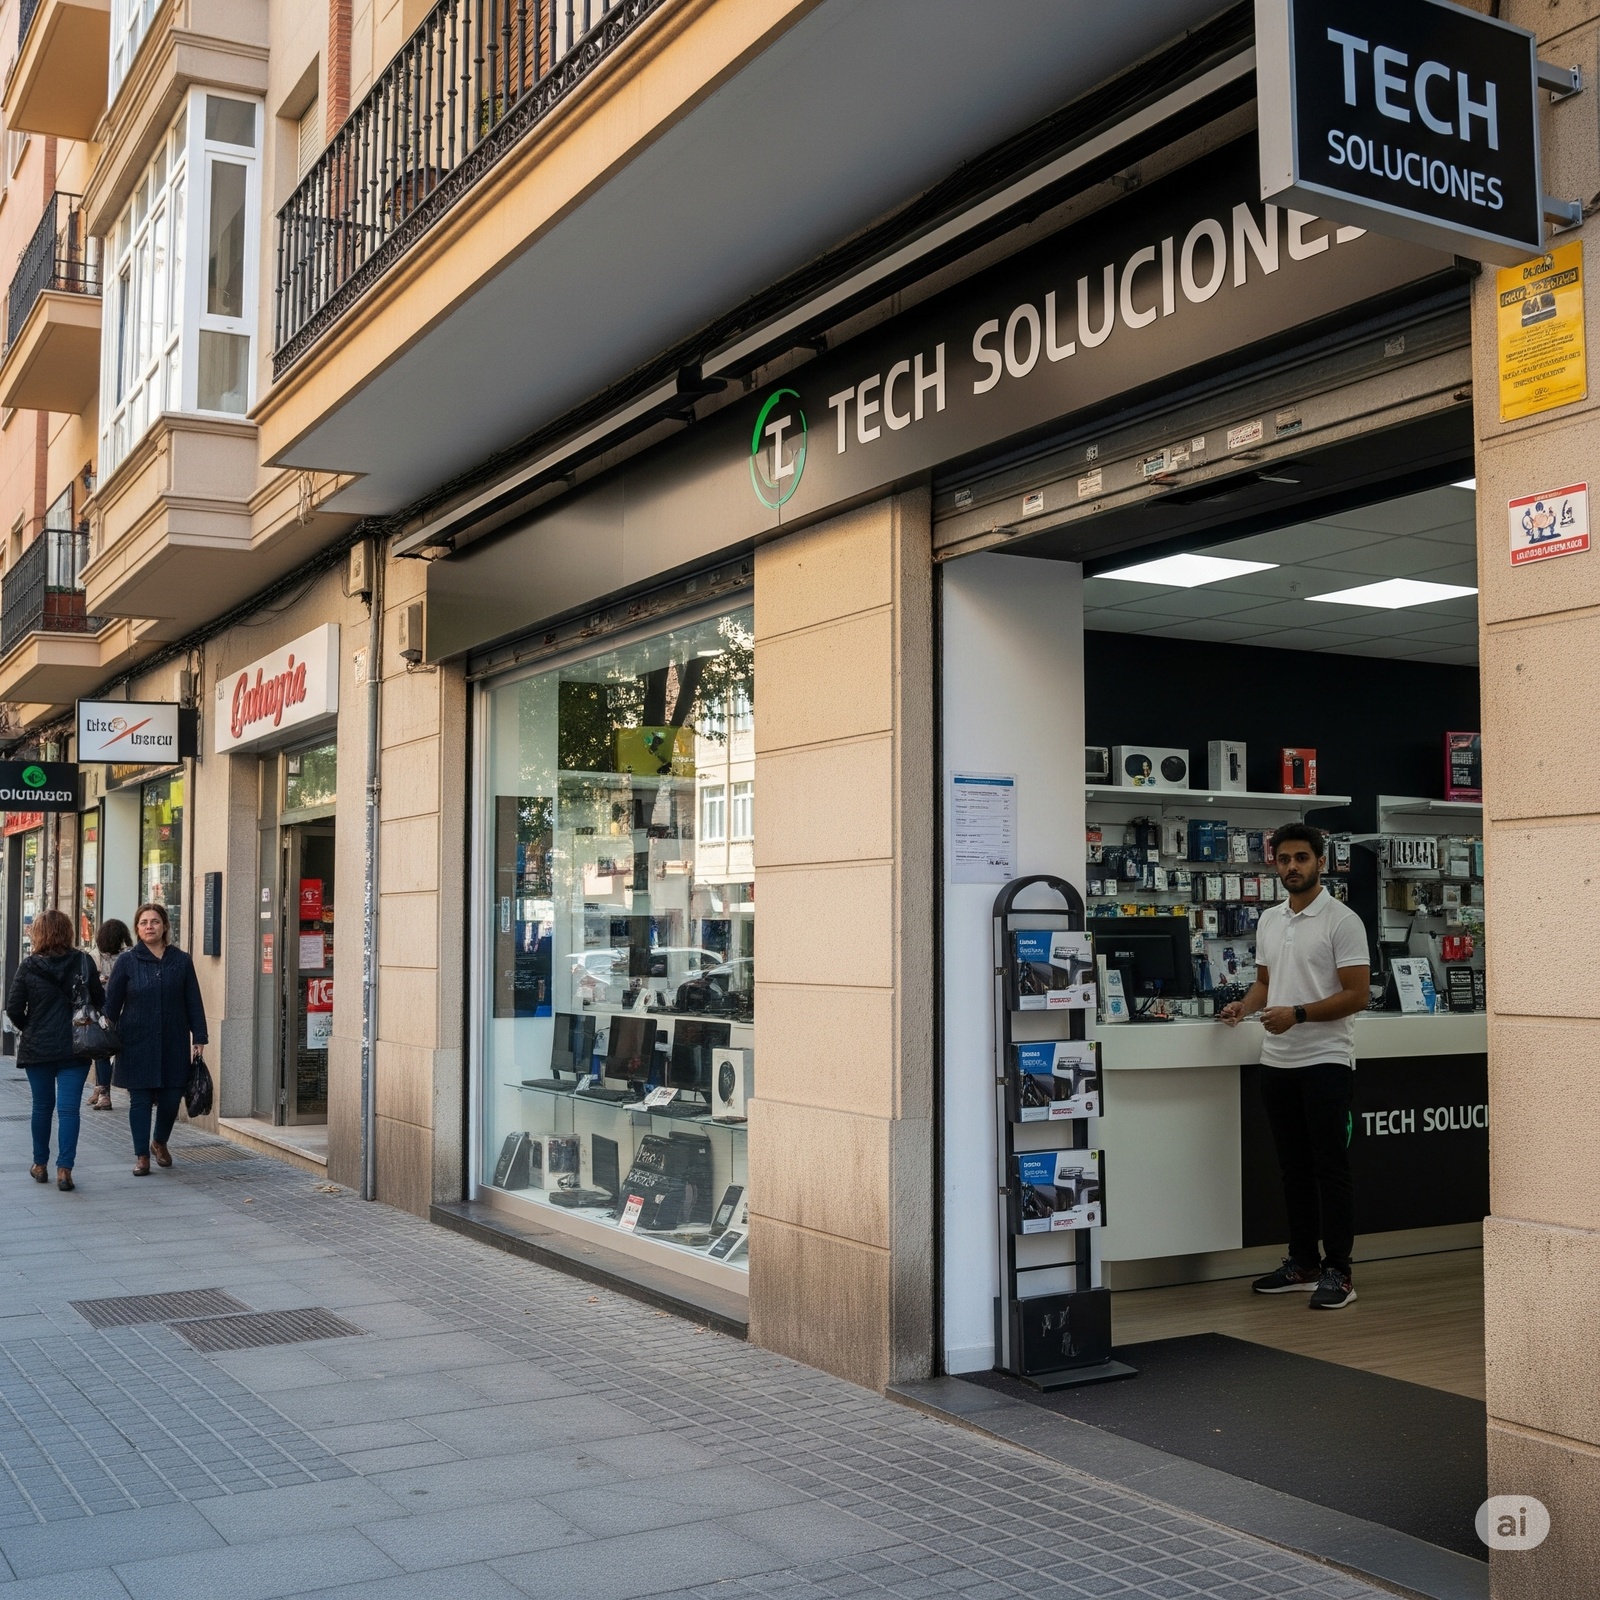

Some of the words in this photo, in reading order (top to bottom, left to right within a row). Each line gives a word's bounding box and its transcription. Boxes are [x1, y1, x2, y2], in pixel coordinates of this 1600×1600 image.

[1327, 27, 1499, 151] TECH
[1327, 129, 1504, 210] SOLUCIONES
[828, 342, 946, 455] TECH
[972, 201, 1369, 395] SOLUCIONE
[1362, 1109, 1415, 1136] TECH
